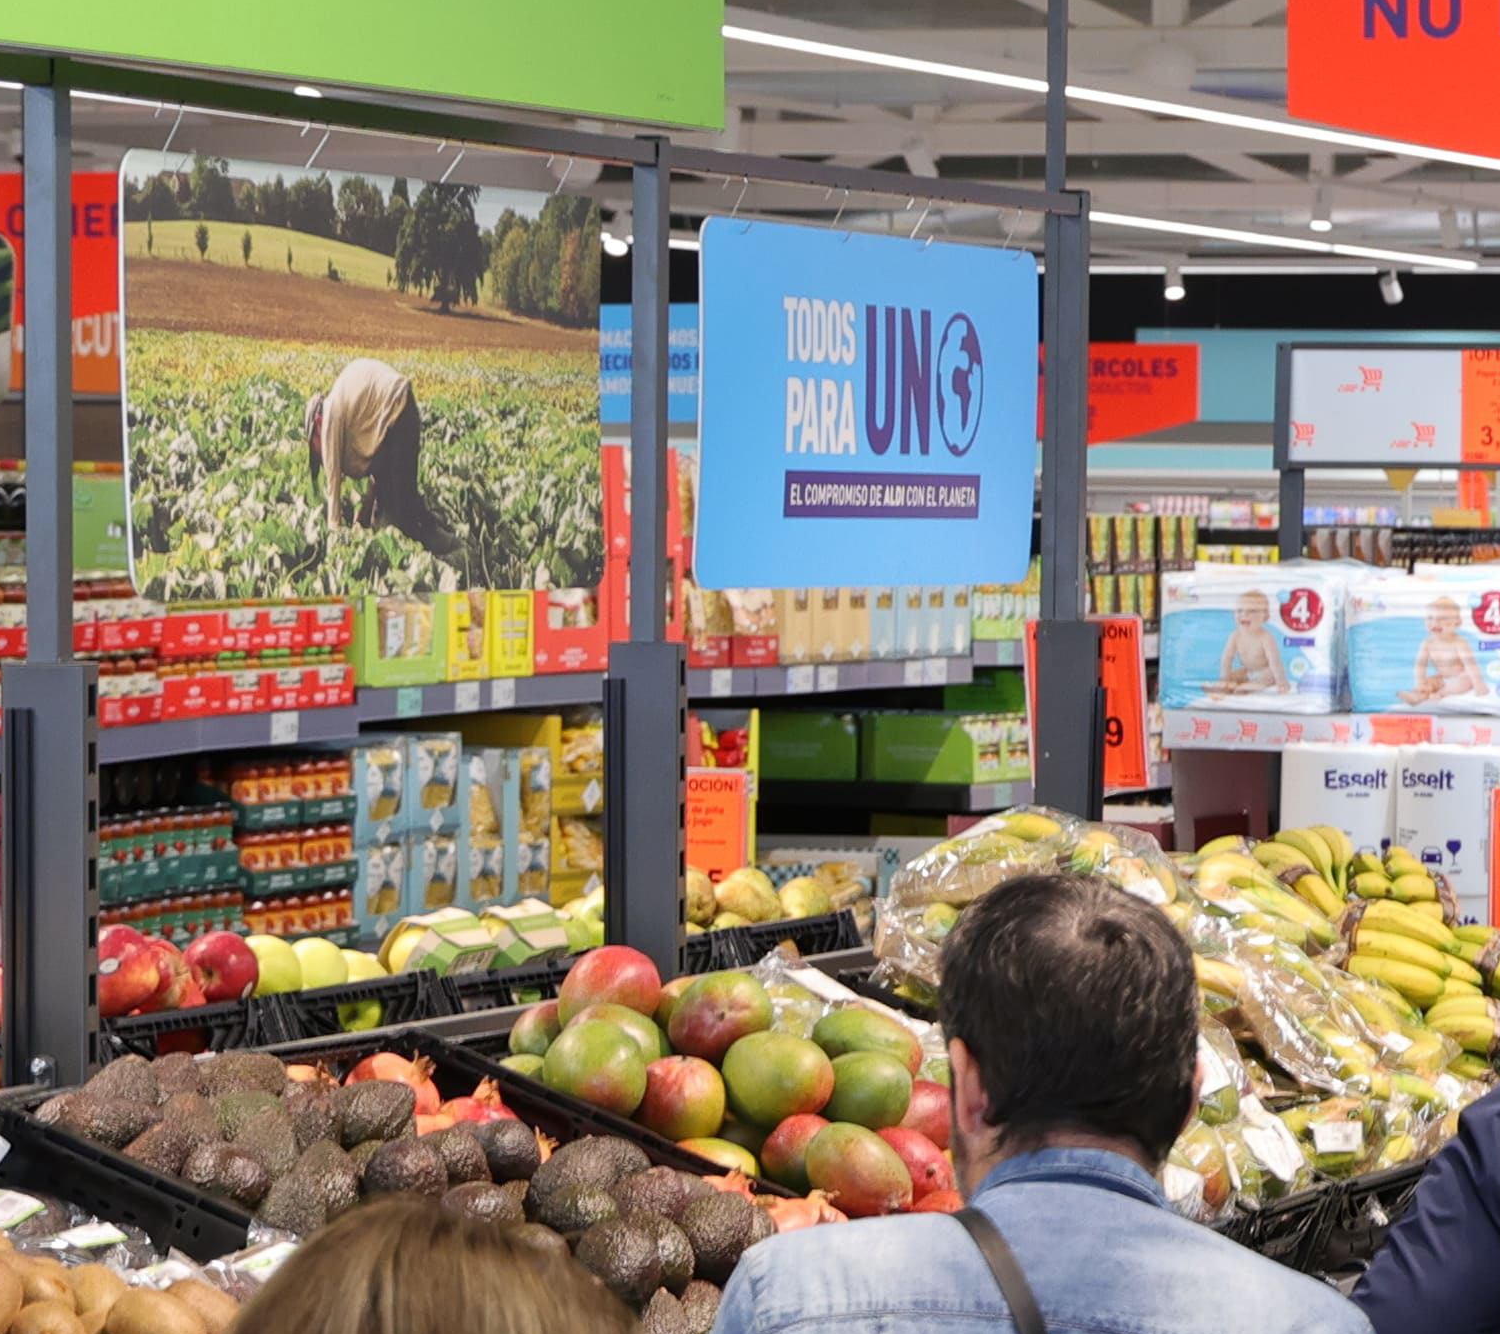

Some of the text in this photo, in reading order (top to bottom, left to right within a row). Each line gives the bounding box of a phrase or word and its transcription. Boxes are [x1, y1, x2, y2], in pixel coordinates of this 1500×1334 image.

[783, 295, 857, 366] TODOS
[1089, 359, 1179, 377] RCOLES
[785, 376, 858, 455] PARA
[790, 483, 977, 508] EL COMPROMISO DE ALDI CON EL PLANETA
[1290, 596, 1311, 624] 4
[688, 777, 738, 793] OCIÓN!
[1323, 768, 1388, 789] Esselt
[1402, 767, 1455, 790] Esselt
